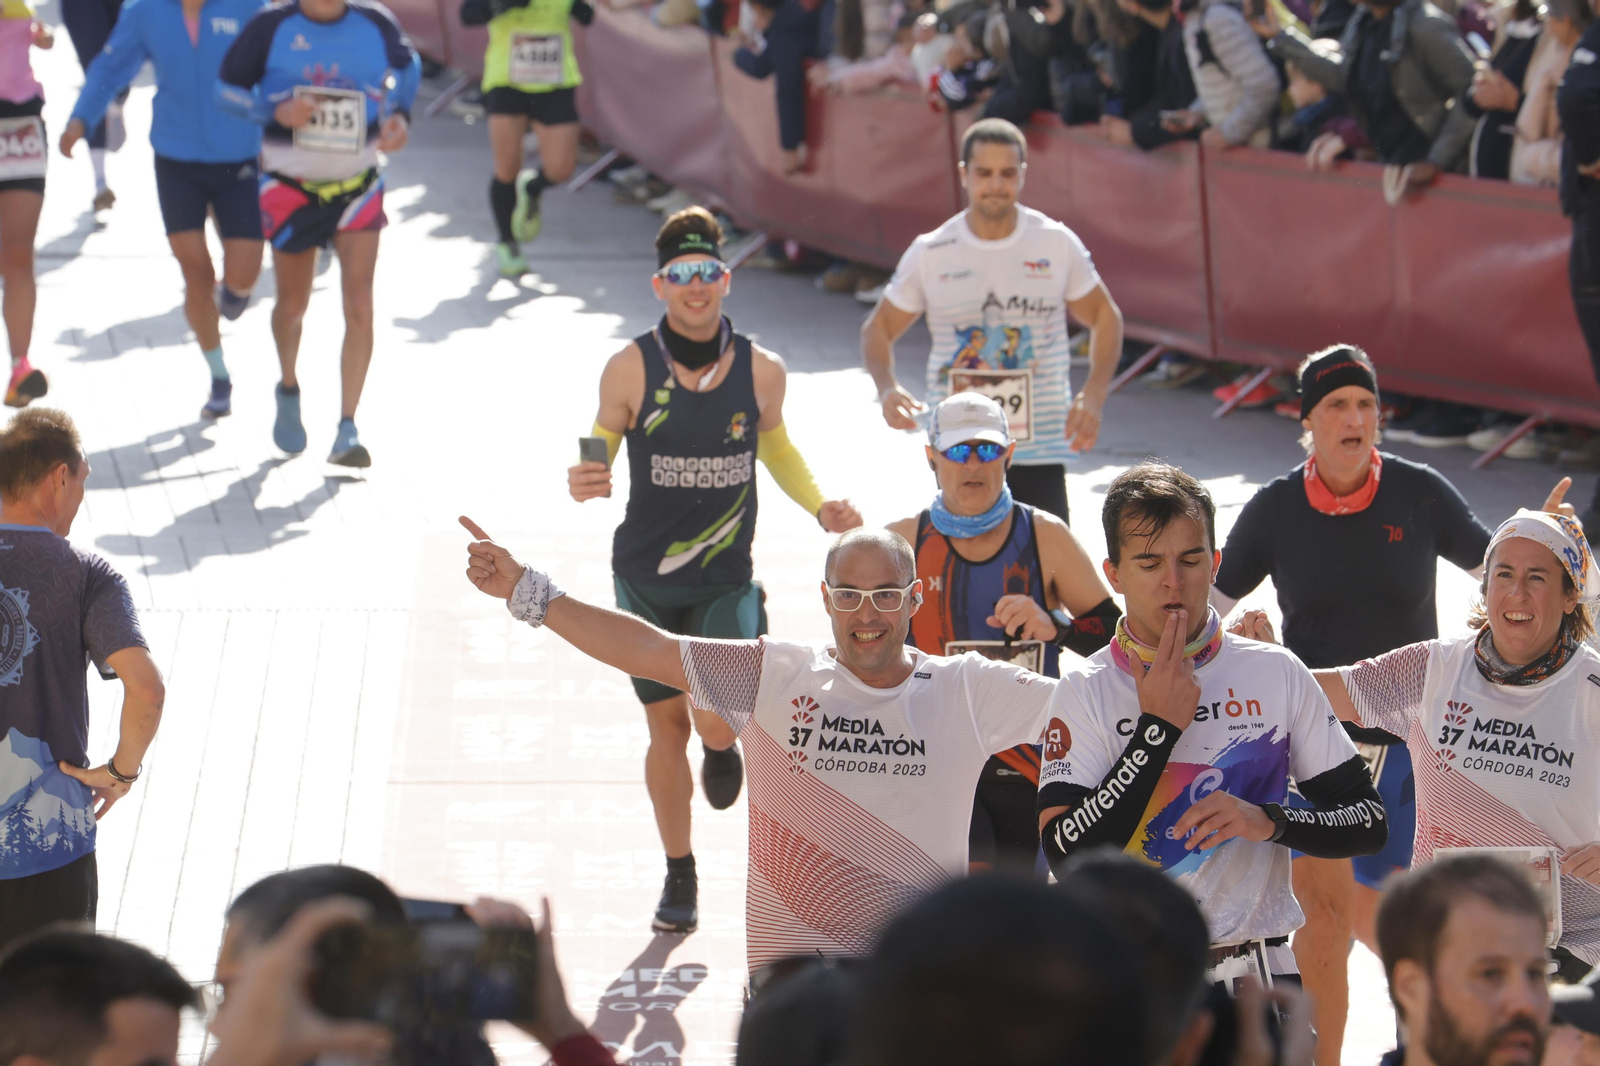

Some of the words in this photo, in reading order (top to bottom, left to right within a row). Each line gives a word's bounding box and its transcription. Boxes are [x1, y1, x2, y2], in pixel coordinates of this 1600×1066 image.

[1116, 688, 1262, 736] cerón
[821, 713, 885, 736] MEDIA
[1227, 722, 1248, 731] desde
[1438, 725, 1465, 746] 37
[1473, 717, 1536, 740] MEDIA
[789, 726, 813, 747] 37
[818, 733, 926, 756] MARATÓN
[1468, 734, 1574, 769] MARATÓN
[815, 756, 887, 774] CÓRDOBA
[893, 763, 926, 776] 2023
[1463, 756, 1534, 779] CÓRDOBA
[1539, 770, 1571, 788] 2023
[1316, 797, 1372, 829] running
